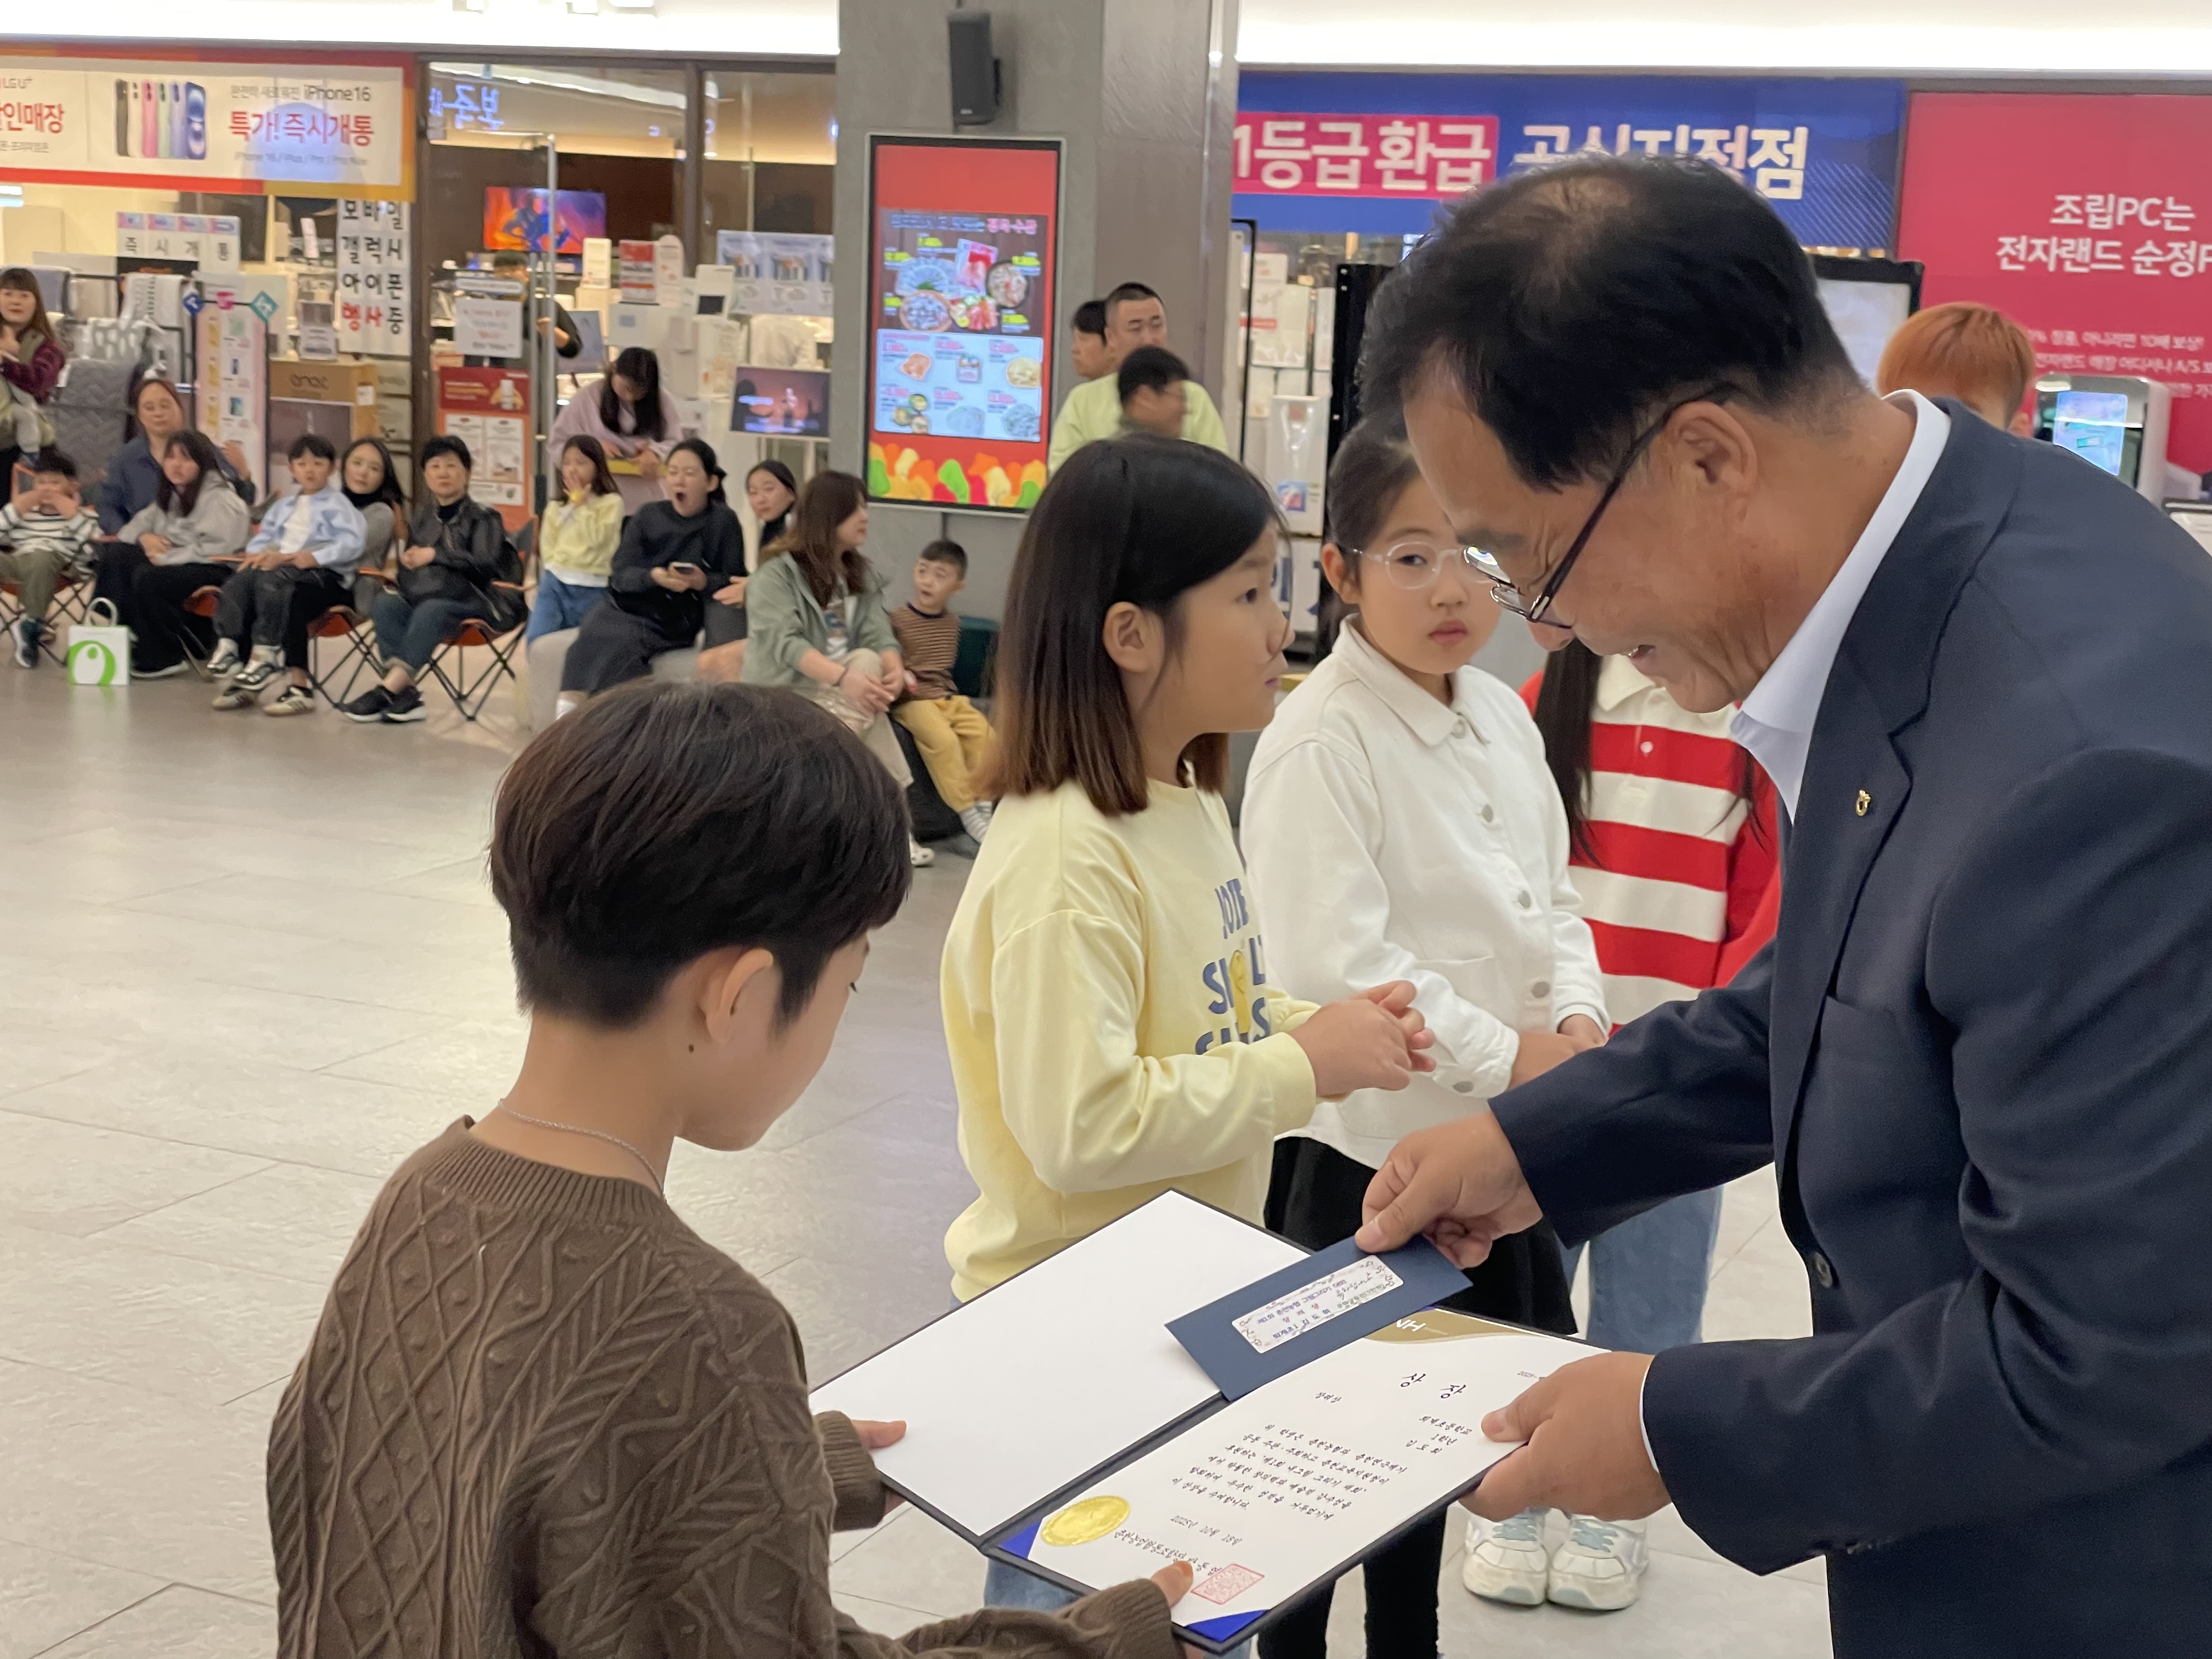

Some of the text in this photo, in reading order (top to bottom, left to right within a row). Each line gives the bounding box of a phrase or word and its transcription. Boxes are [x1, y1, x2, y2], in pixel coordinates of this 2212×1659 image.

[0, 102, 65, 134] 인매장
[229, 111, 374, 146] 특가! 즉시개통
[1233, 120, 1491, 193] 1등급 환급
[2050, 193, 2196, 232] 조립PC는
[341, 236, 403, 264] 갤럭시
[1996, 235, 2124, 273] 전자랜드
[342, 273, 404, 300] 아이폰
[1401, 1373, 1466, 1398] 상 장
